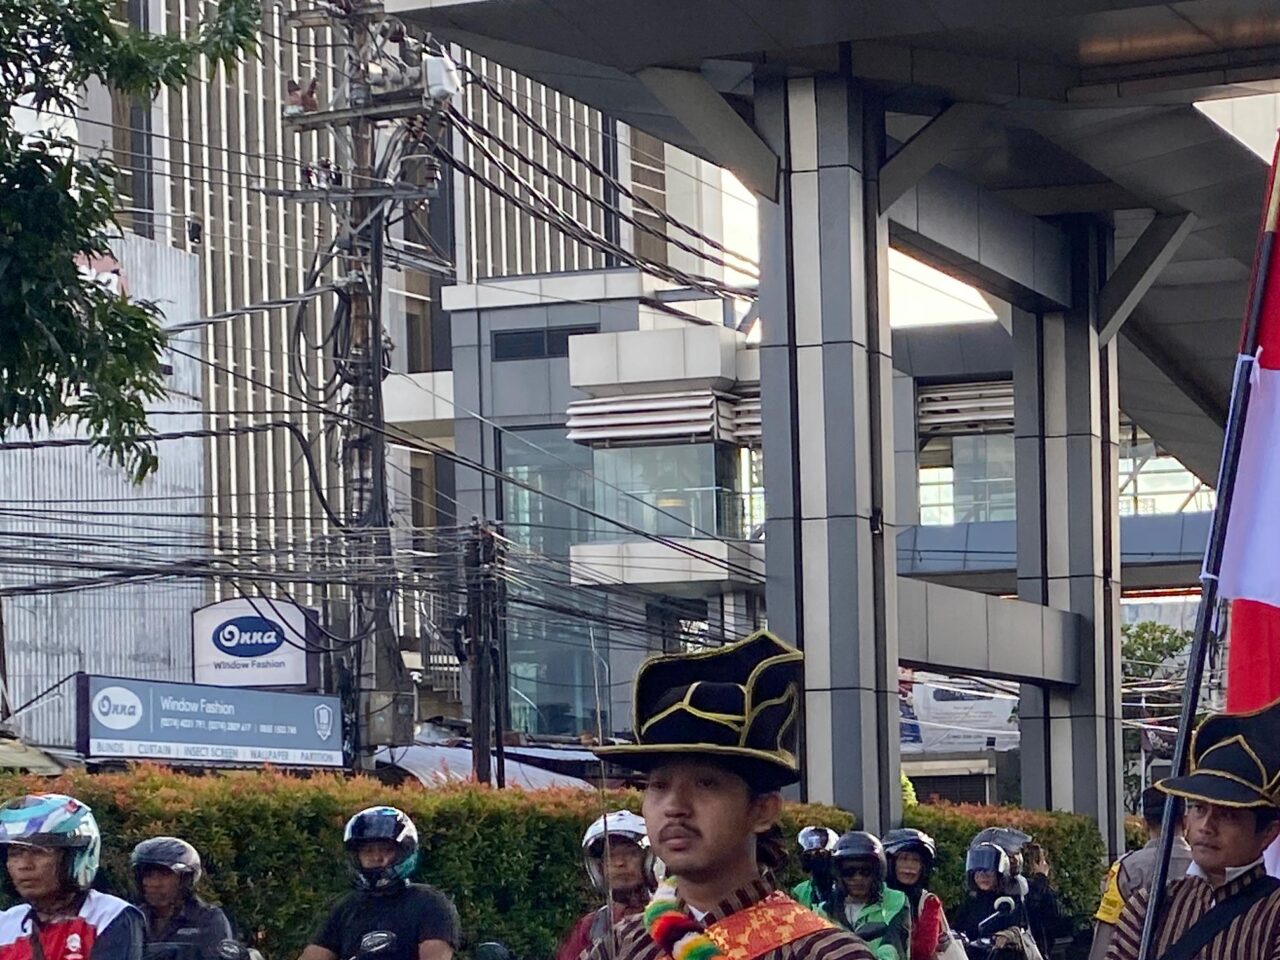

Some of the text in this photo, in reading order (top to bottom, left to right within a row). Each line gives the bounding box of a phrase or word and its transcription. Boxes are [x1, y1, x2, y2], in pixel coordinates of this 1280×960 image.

[220, 625, 277, 647] Onna
[213, 660, 285, 669] Window Fashion
[98, 695, 136, 717] Onna
[160, 696, 235, 715] Window Fashion
